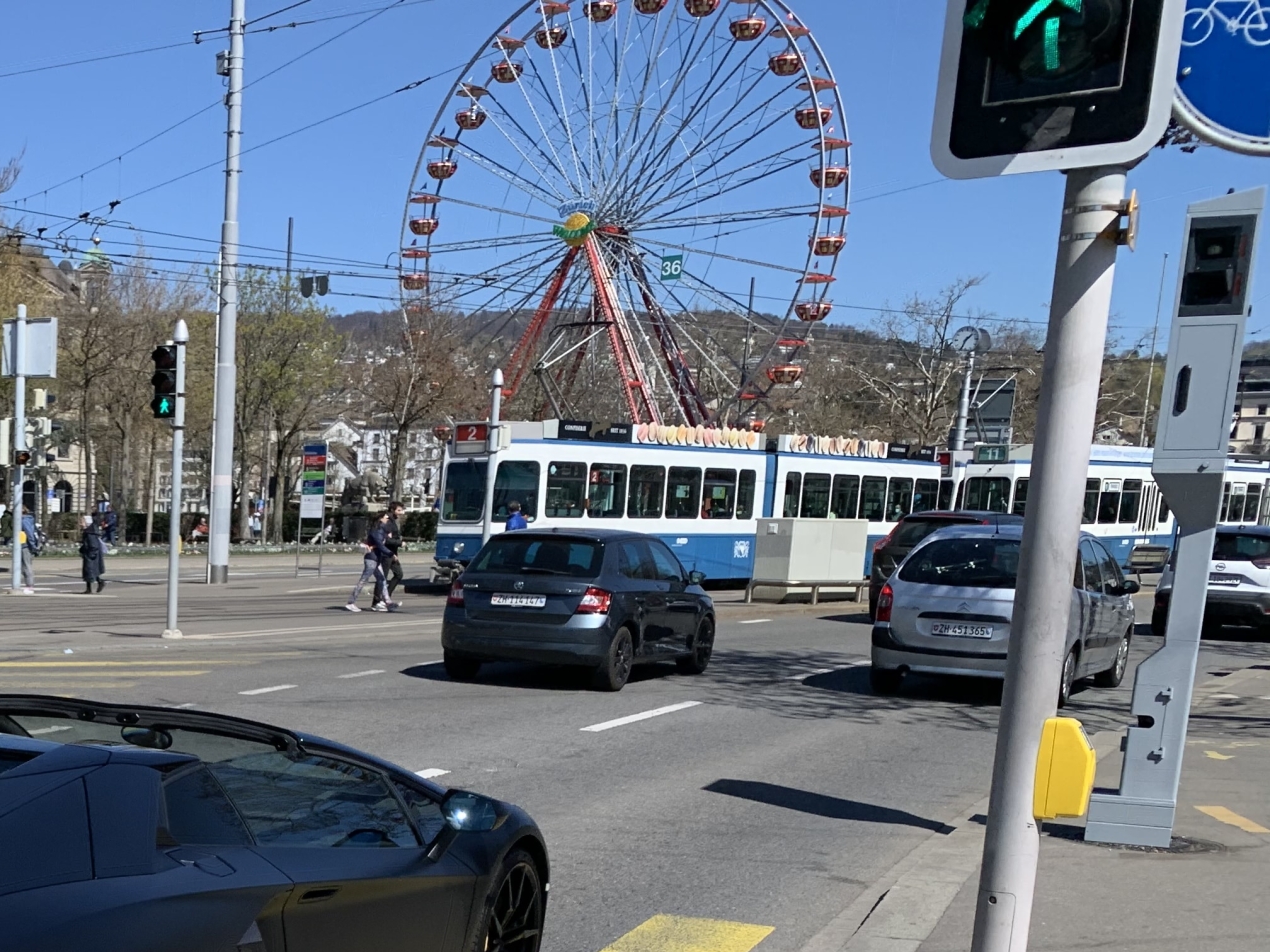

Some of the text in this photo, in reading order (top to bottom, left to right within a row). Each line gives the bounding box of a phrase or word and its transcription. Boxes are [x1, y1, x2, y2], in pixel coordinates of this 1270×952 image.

[661, 260, 681, 276] 36
[467, 426, 477, 441] 2
[987, 448, 999, 460] 11
